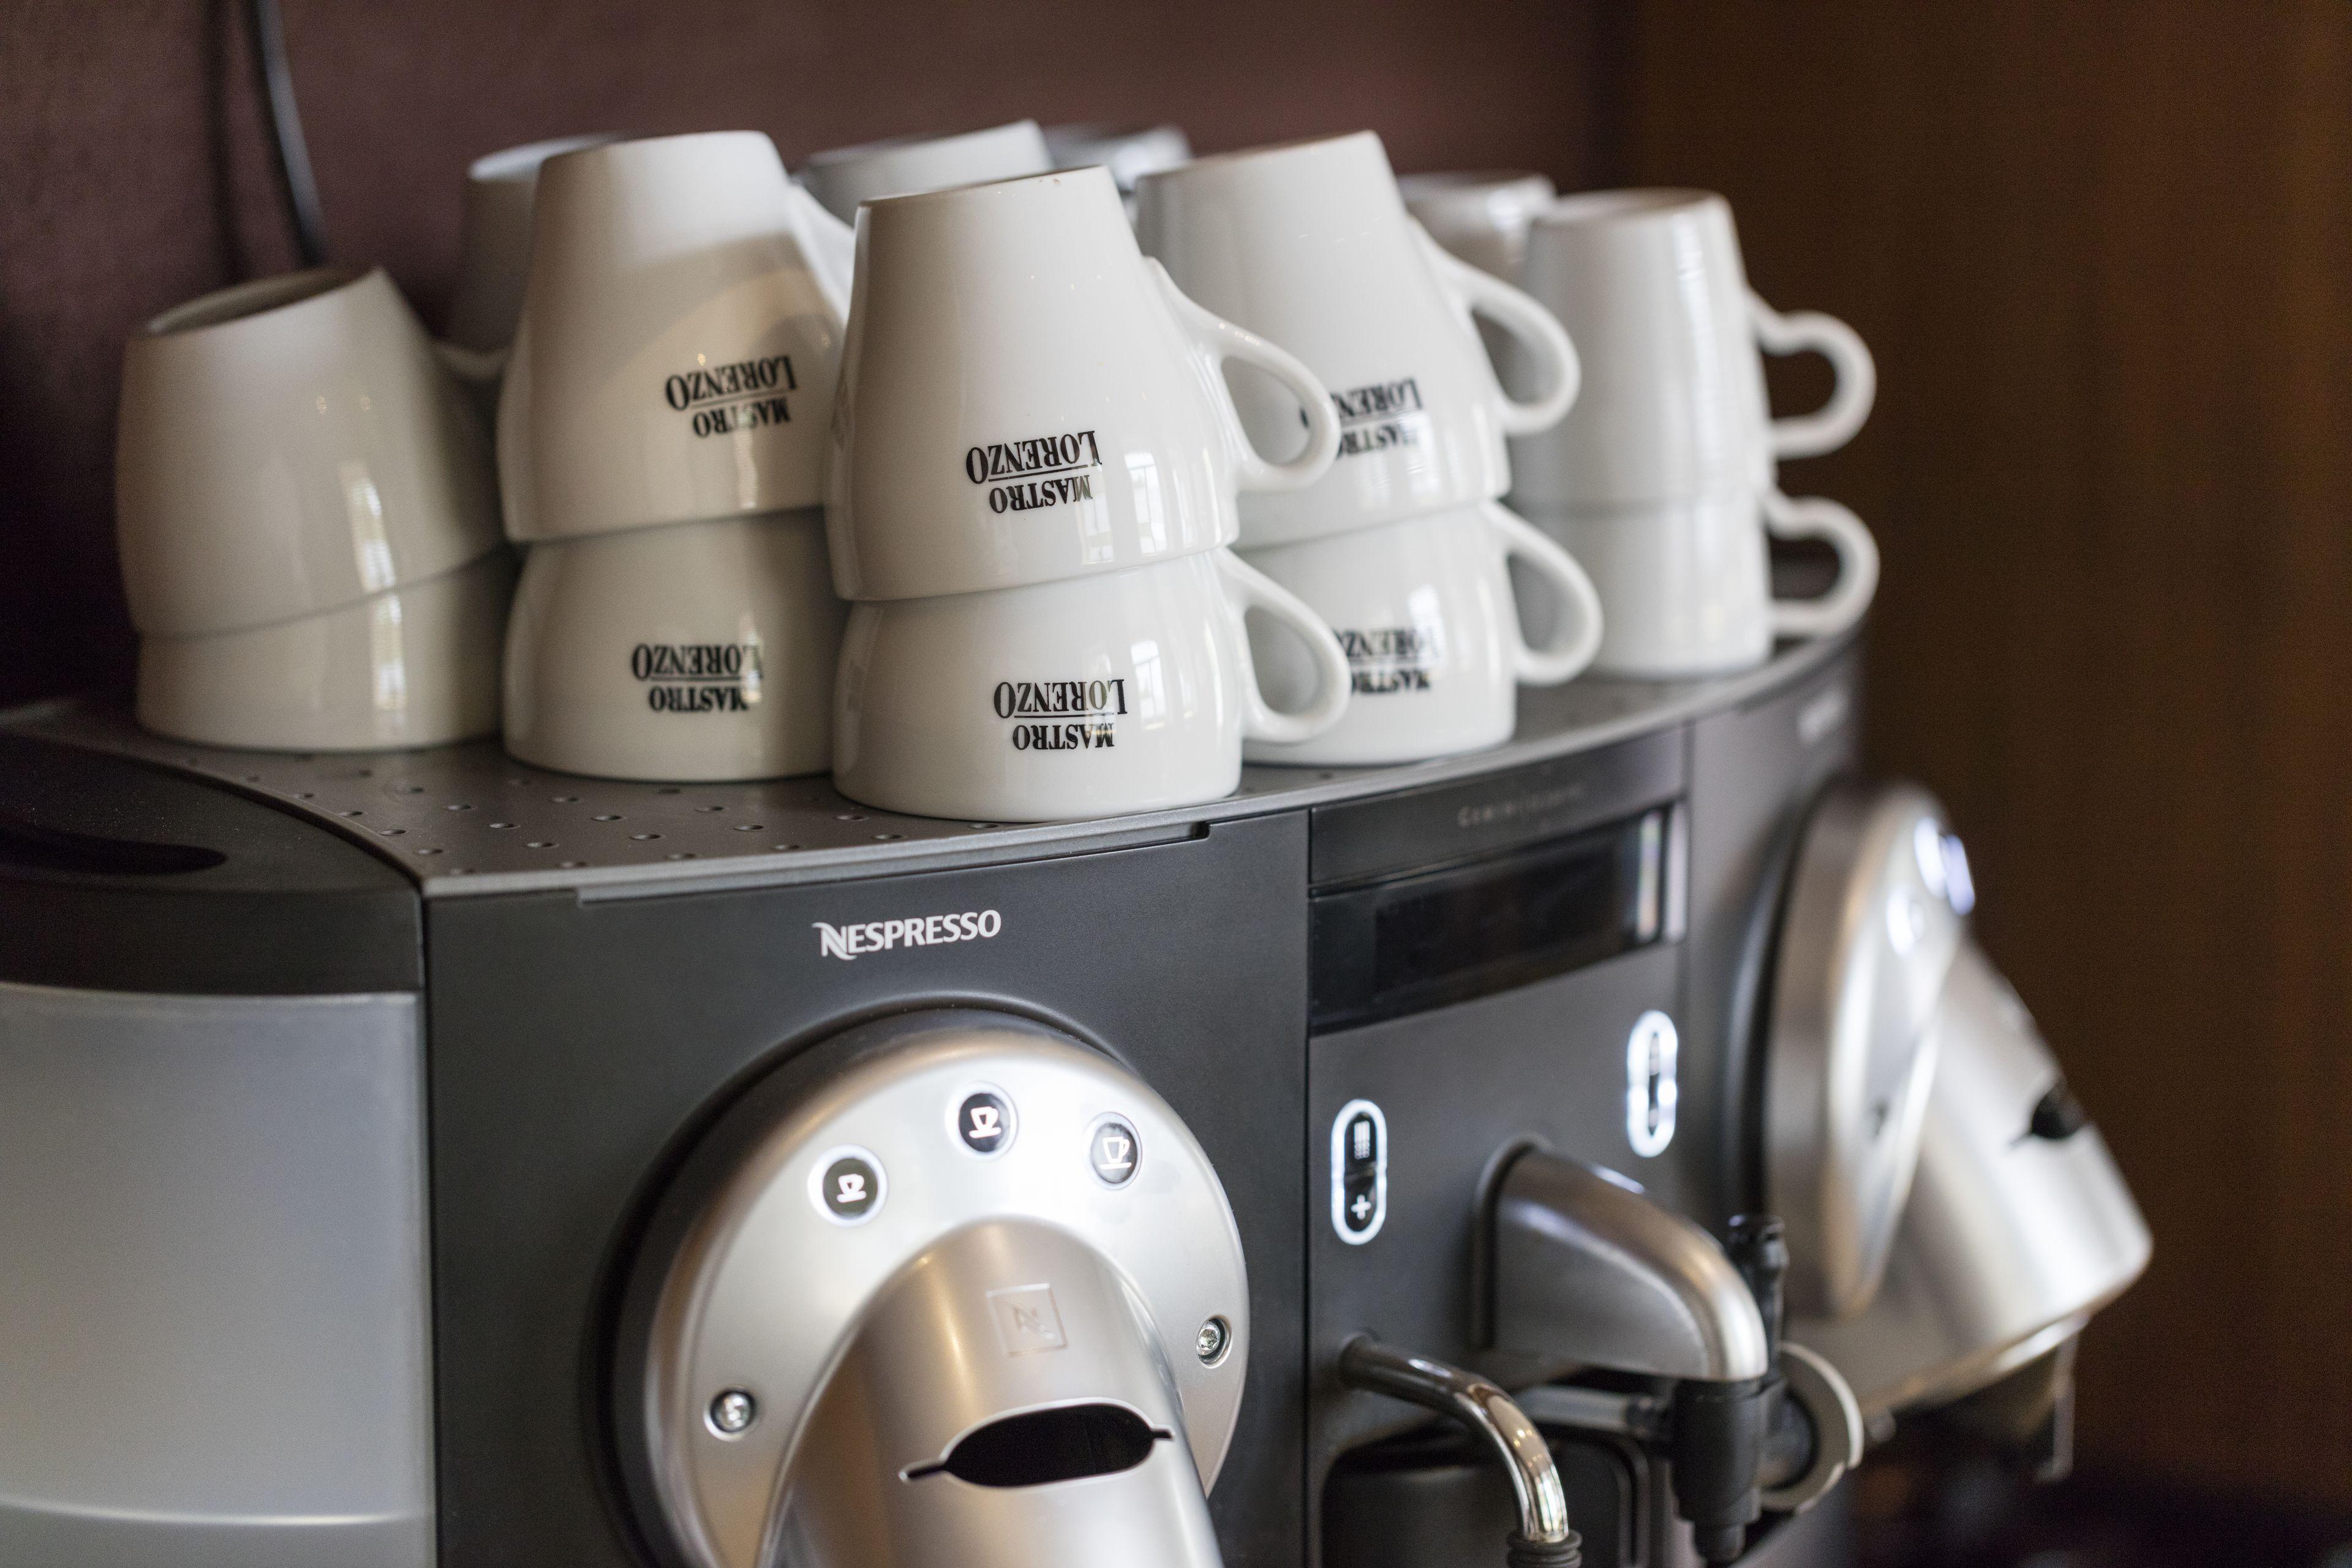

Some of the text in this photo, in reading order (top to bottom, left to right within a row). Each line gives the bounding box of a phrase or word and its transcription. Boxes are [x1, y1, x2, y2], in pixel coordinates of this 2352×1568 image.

[665, 353, 797, 411] LORENZO
[965, 430, 1102, 484] LORENZO
[989, 475, 1093, 513] MASTRO
[631, 643, 763, 681] LORENZO
[648, 686, 748, 712] MASTRO
[993, 679, 1128, 718] LORENZO
[1012, 723, 1114, 750] MASTRO
[812, 910, 1001, 960] NESPRESSO
